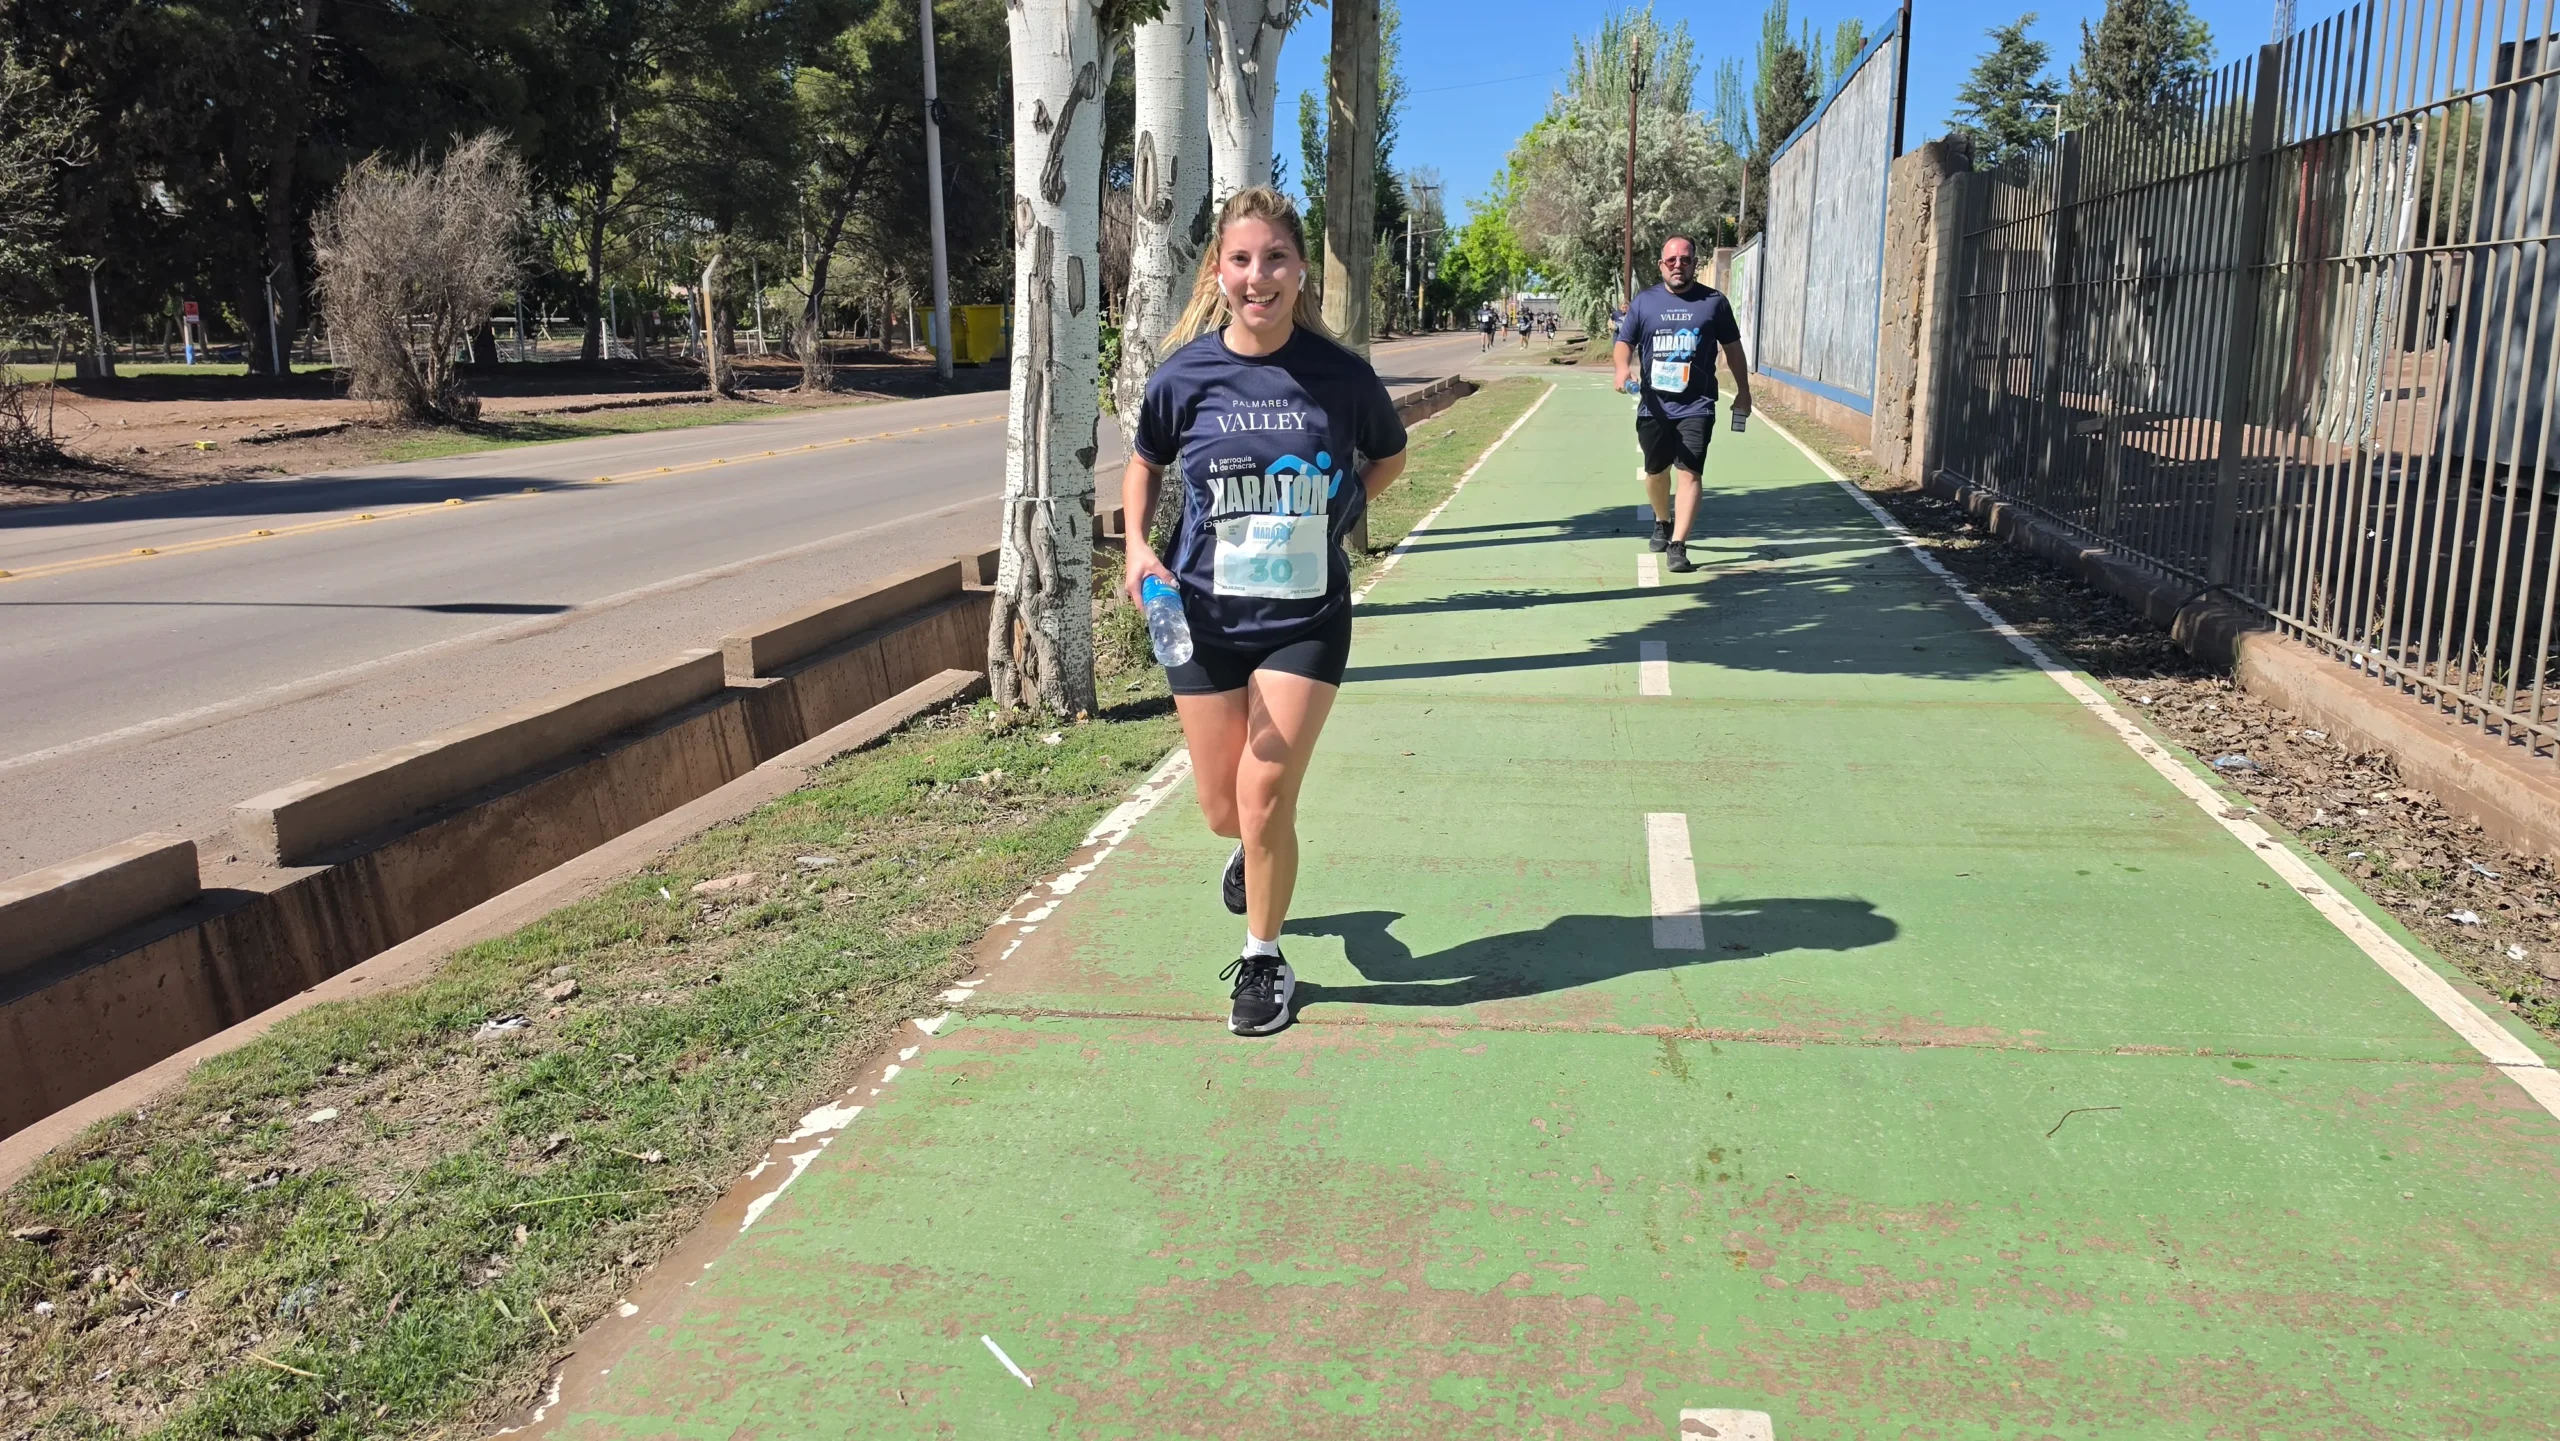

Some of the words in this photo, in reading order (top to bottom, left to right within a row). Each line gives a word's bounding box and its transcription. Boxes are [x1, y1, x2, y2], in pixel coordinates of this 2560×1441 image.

[1660, 313, 1693, 321] VALLEY
[1232, 399, 1289, 408] PALMARES
[1216, 412, 1307, 434] VALLEY
[1219, 455, 1252, 465] parroquia
[1229, 462, 1256, 470] chacras
[1248, 557, 1293, 584] 30
